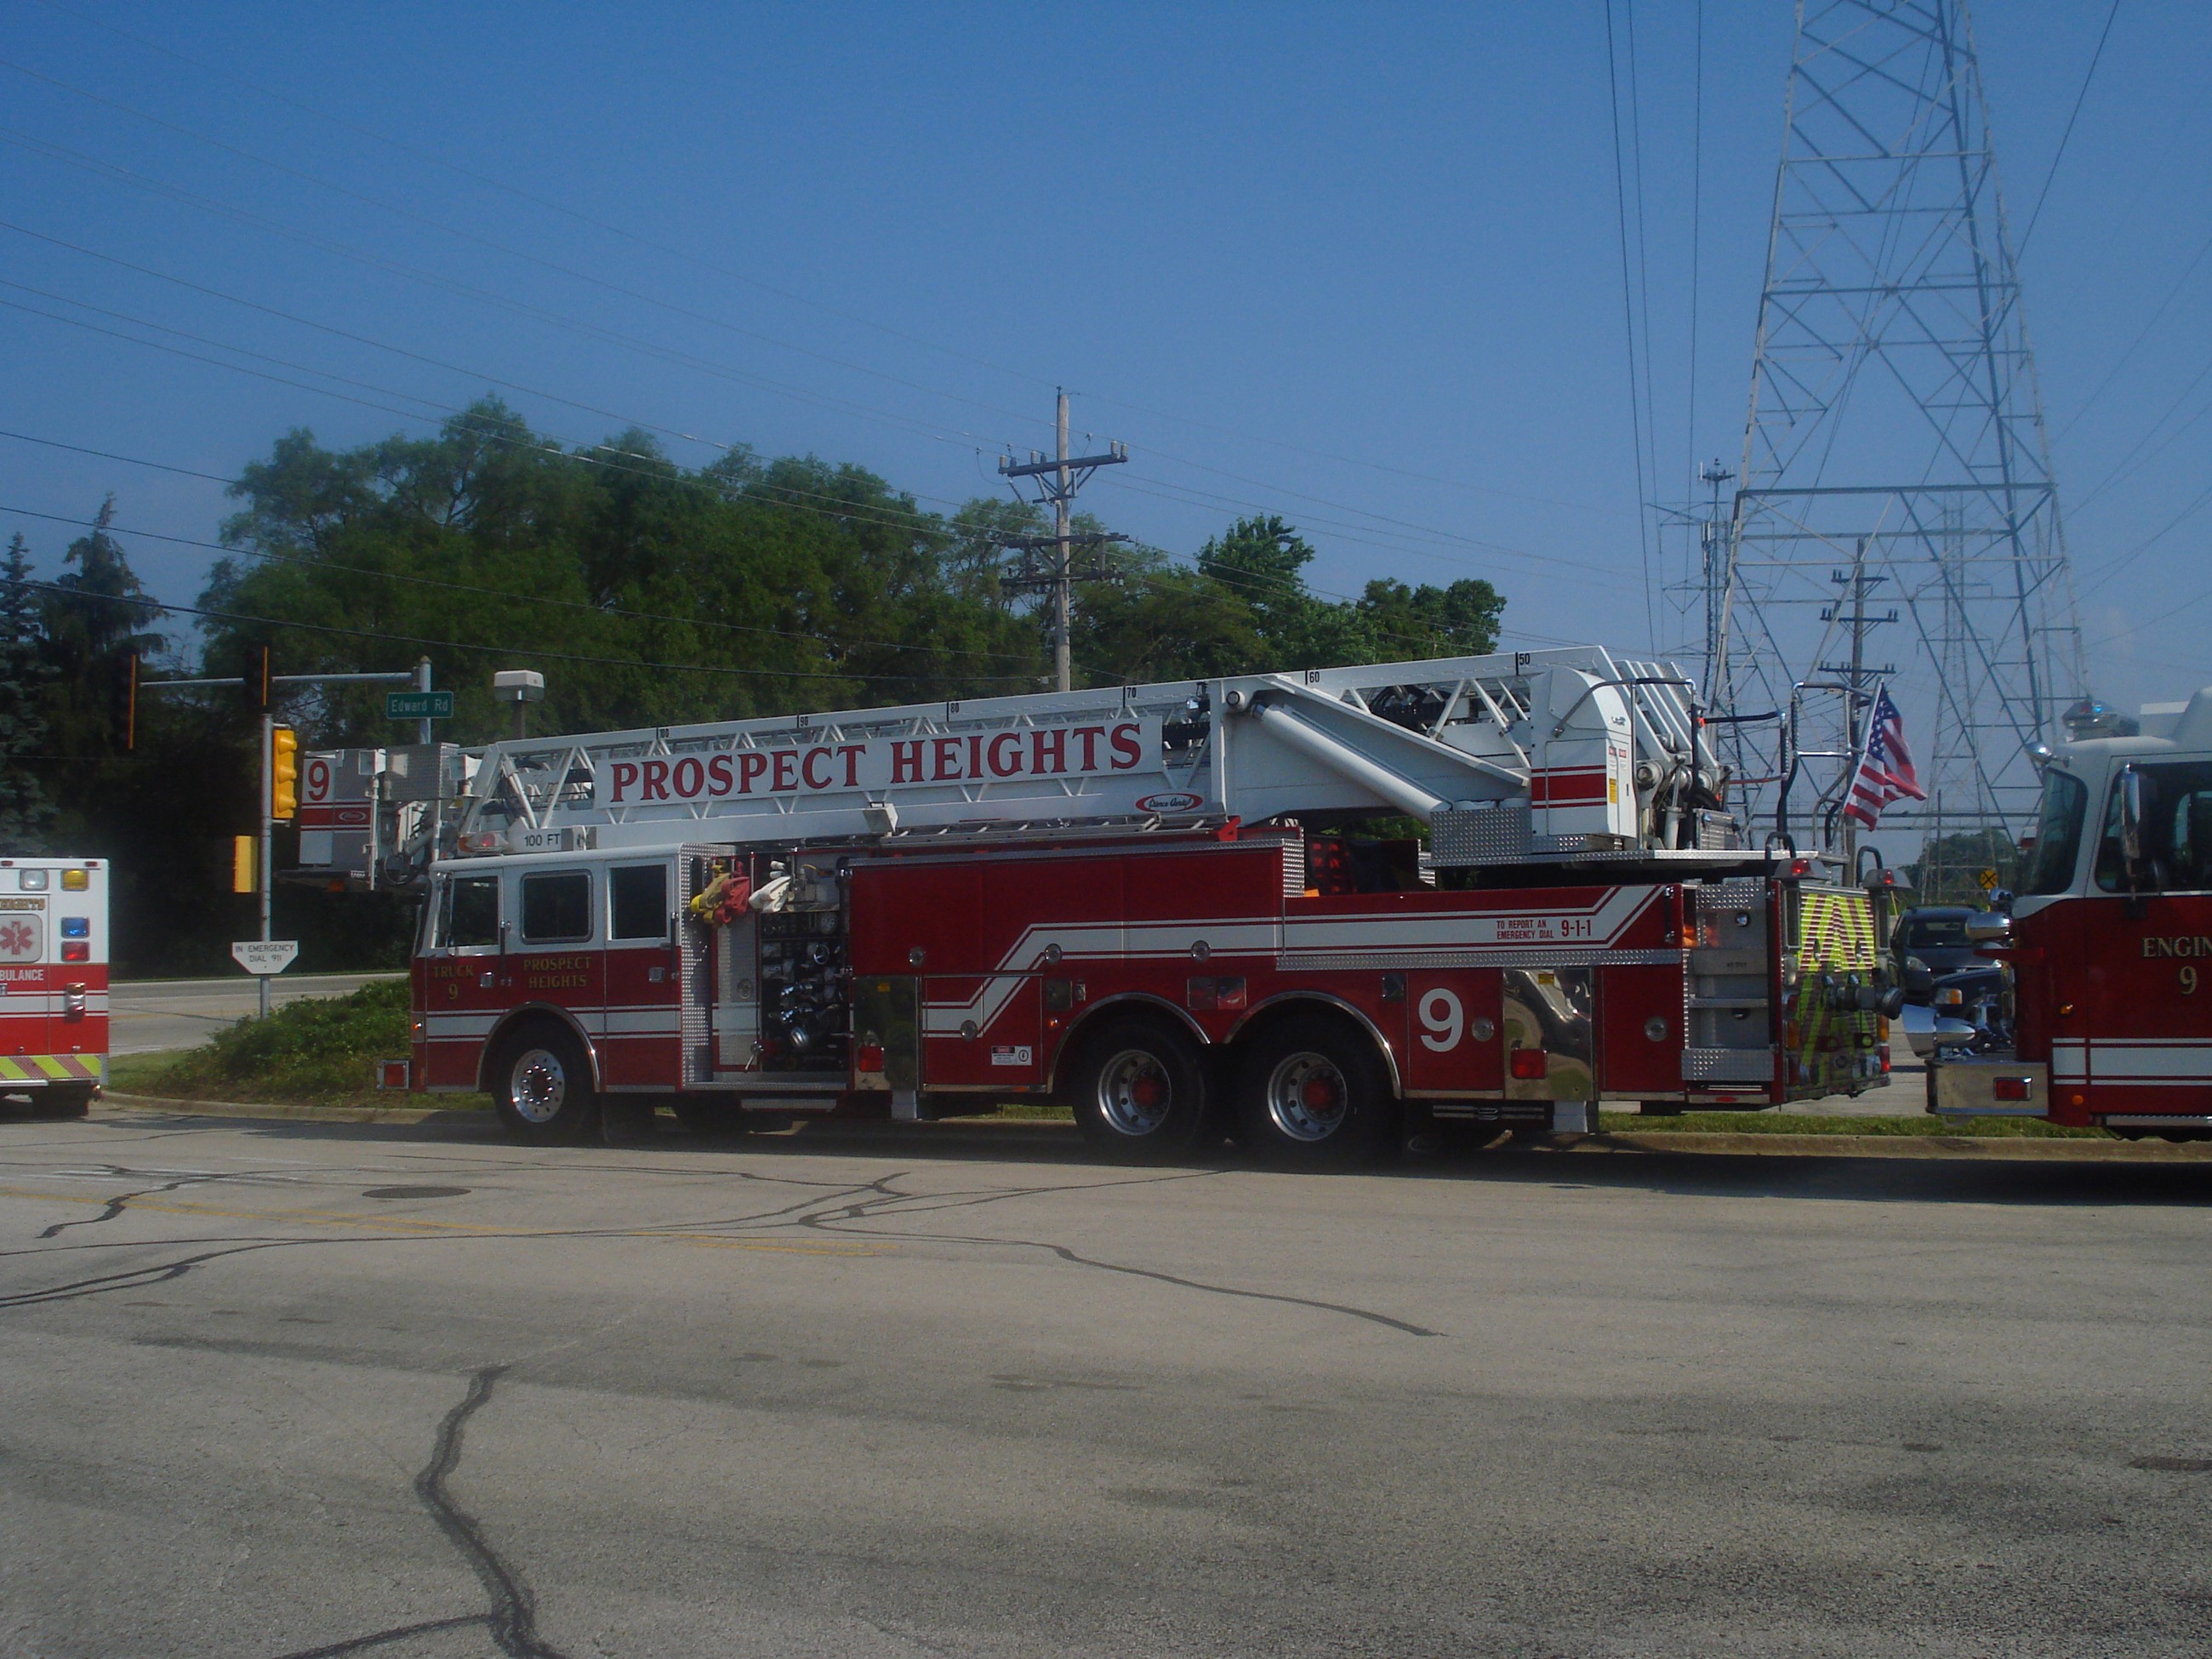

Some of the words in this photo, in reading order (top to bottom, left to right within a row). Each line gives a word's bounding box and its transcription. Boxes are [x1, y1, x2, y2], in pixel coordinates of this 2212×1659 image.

[1519, 653, 1531, 665] 50
[1308, 671, 1320, 683] 60
[1126, 687, 1137, 698] 70
[391, 699, 427, 712] Edward
[435, 698, 448, 711] Rd
[950, 703, 960, 714] 80
[610, 744, 866, 802] PROSPECT
[890, 723, 1142, 784] HEIGHTS
[308, 760, 330, 801] 9
[524, 835, 543, 847] 100
[547, 833, 561, 846] FT
[1497, 920, 1505, 929] TO
[1508, 919, 1534, 929] REPORT
[1537, 919, 1547, 928] AN
[1561, 919, 1591, 937] 9-1-1
[1497, 930, 1536, 940] EMERGENCY
[1539, 929, 1554, 938] DIAL
[248, 944, 295, 953] EMERGENCY
[249, 955, 267, 963] DIAL
[271, 954, 282, 962] 911
[523, 955, 592, 972] PROSPECT
[433, 965, 474, 978] TRUCK
[528, 974, 588, 989] HEIGHTS
[2180, 966, 2198, 995] 9
[448, 983, 459, 1001] 9
[1418, 987, 1464, 1052] 9
